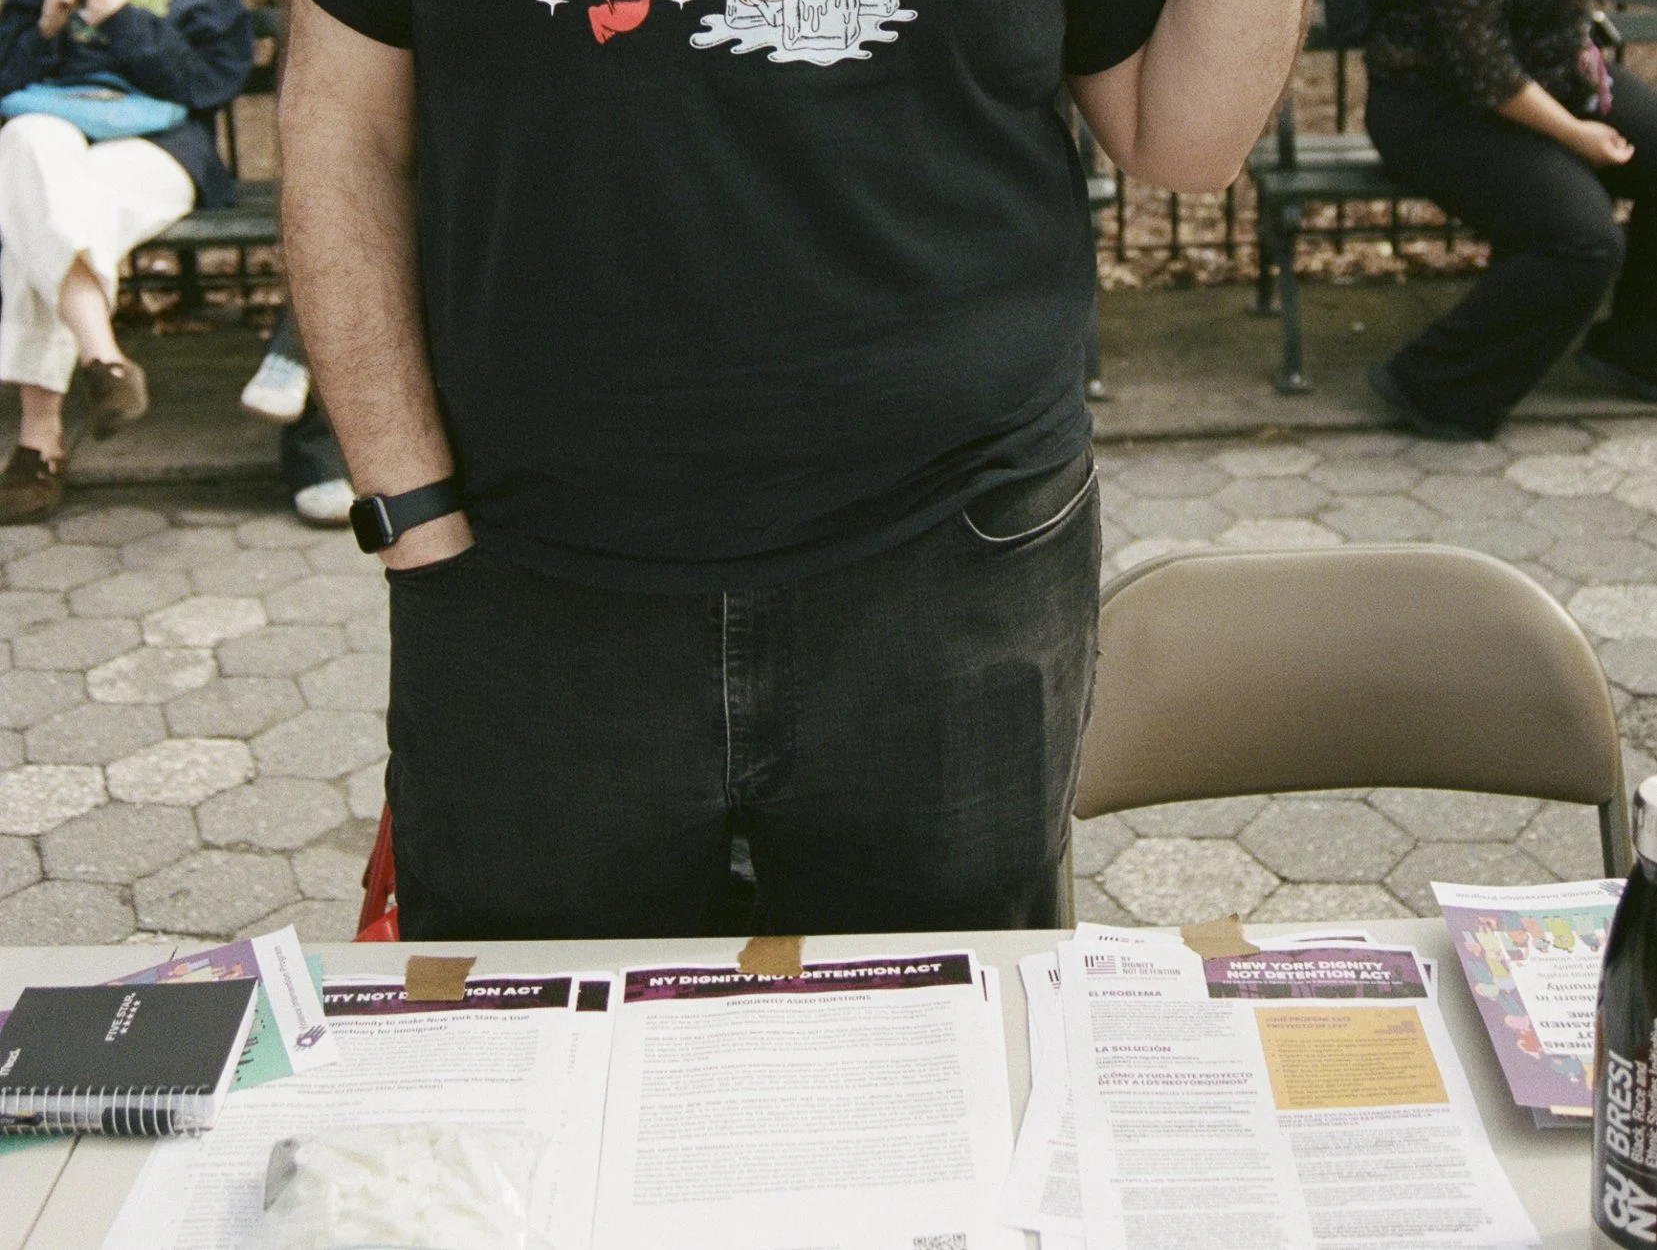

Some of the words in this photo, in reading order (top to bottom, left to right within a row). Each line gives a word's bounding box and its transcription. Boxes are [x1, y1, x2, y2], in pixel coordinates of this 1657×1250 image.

[649, 976, 677, 987] NY
[679, 974, 755, 985] DIGNITY
[800, 966, 901, 979] DETENTION
[903, 963, 942, 974] ACT
[1226, 970, 1262, 979] NOT
[1264, 970, 1357, 979] DETENTION
[1360, 970, 1392, 980] ACT
[1229, 961, 1267, 970] NEW
[1269, 961, 1316, 970] YORK
[1317, 961, 1384, 970] DIGNITY
[357, 992, 397, 1003] NOT
[503, 986, 543, 996] ACT
[1547, 983, 1597, 992] munity
[726, 998, 784, 1007] FREQUENTLY
[786, 997, 817, 1005] ASKED
[819, 994, 872, 1003] QUESTIONS
[105, 1017, 122, 1042] FIVE
[1111, 1043, 1172, 1053] SOLUCIÓN
[1543, 1041, 1594, 1049] INENS
[1633, 1060, 1647, 1087] and
[1606, 1050, 1634, 1157] BRESI
[1632, 1088, 1646, 1123] Race
[1604, 1163, 1631, 1229] CU
[1626, 1178, 1657, 1242] NY
